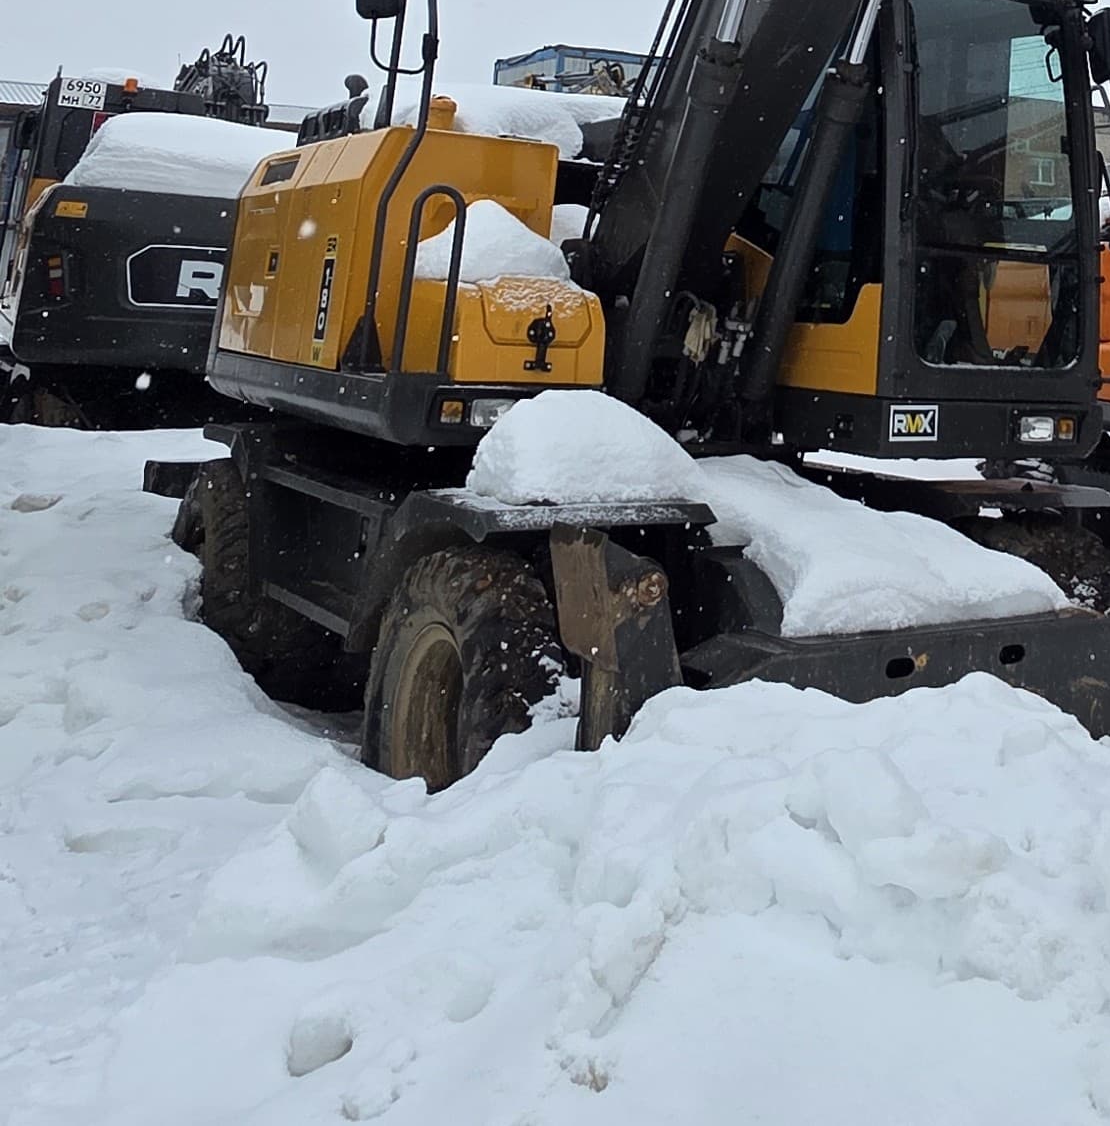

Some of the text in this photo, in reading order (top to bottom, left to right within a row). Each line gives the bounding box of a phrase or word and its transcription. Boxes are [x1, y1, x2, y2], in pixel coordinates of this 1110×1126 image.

[66, 79, 101, 94] 6950
[88, 95, 101, 105] 77
[317, 267, 331, 331] 180
[893, 410, 934, 434] RMX
